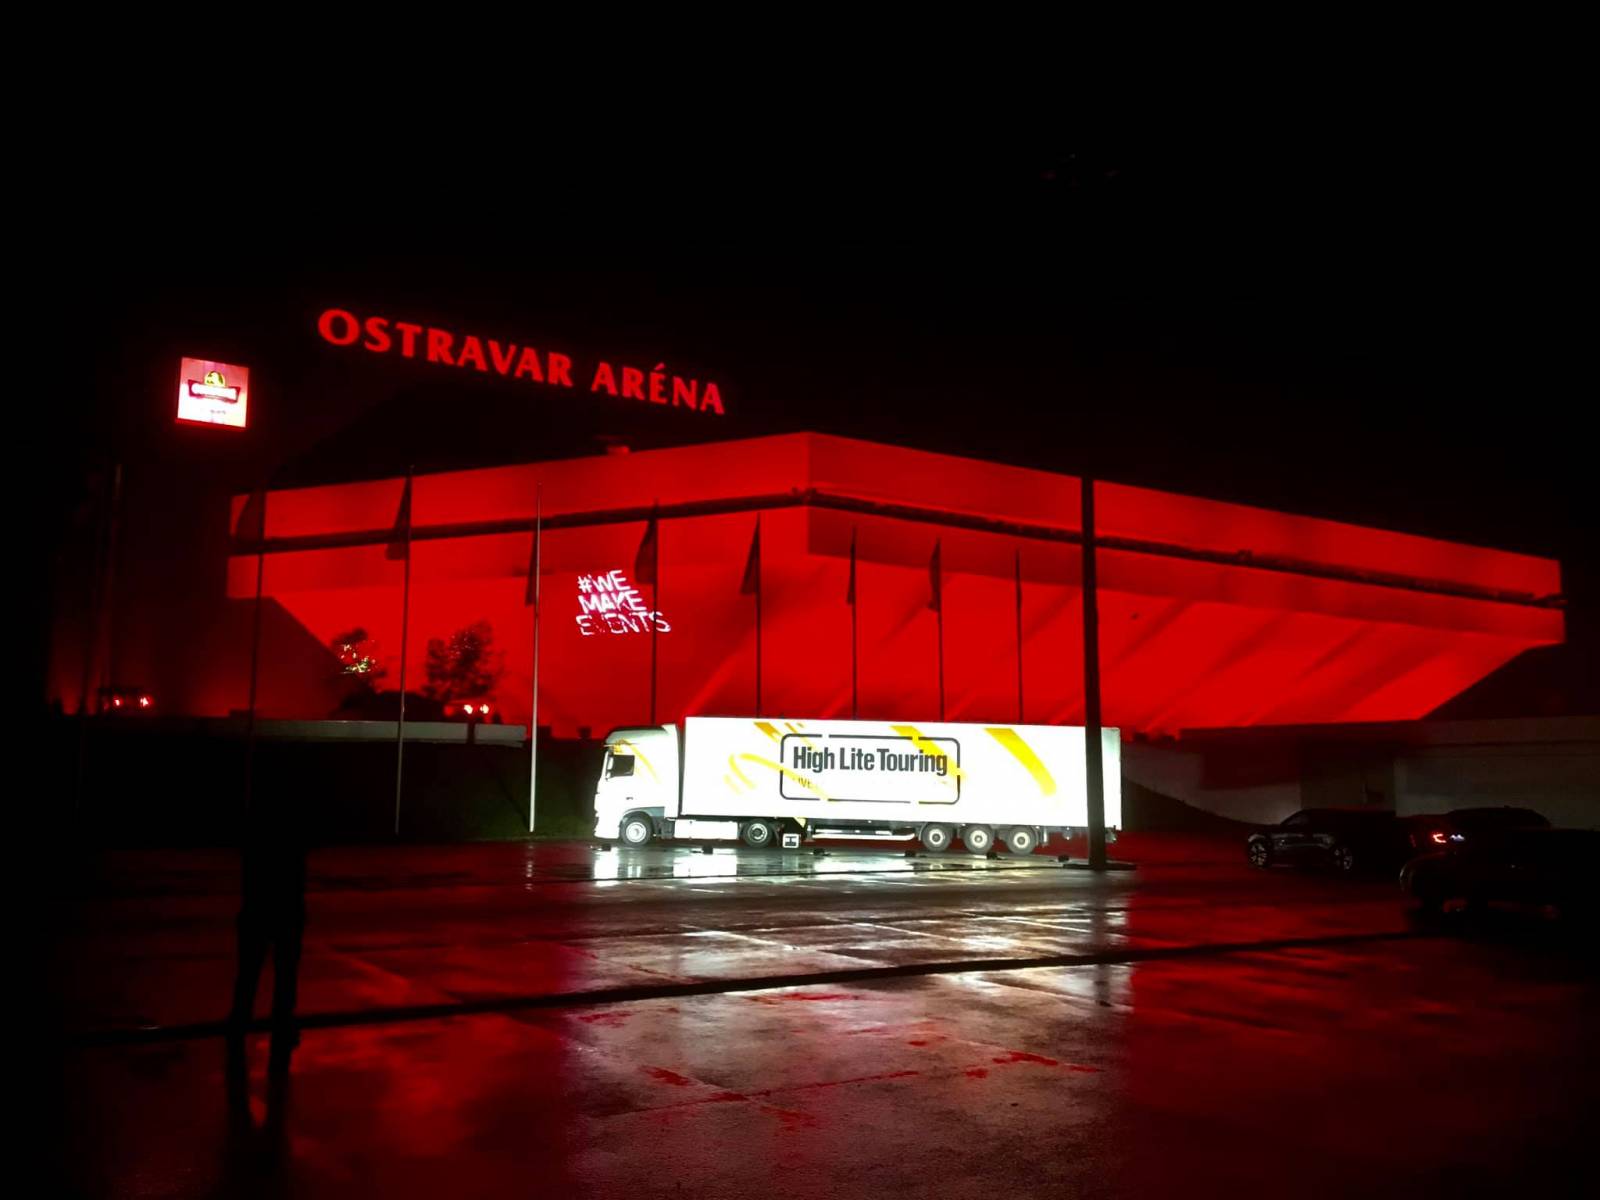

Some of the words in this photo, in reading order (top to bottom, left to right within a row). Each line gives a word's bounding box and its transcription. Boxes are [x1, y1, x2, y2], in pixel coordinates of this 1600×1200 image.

[317, 308, 573, 388] OSTRAVAR
[591, 362, 725, 415] ARÉNA
[576, 569, 631, 594] #WE
[577, 589, 647, 614] MAKE
[575, 611, 672, 636] EENTS
[793, 746, 835, 773] High
[839, 747, 875, 771] Lite
[876, 748, 948, 776] Touring
